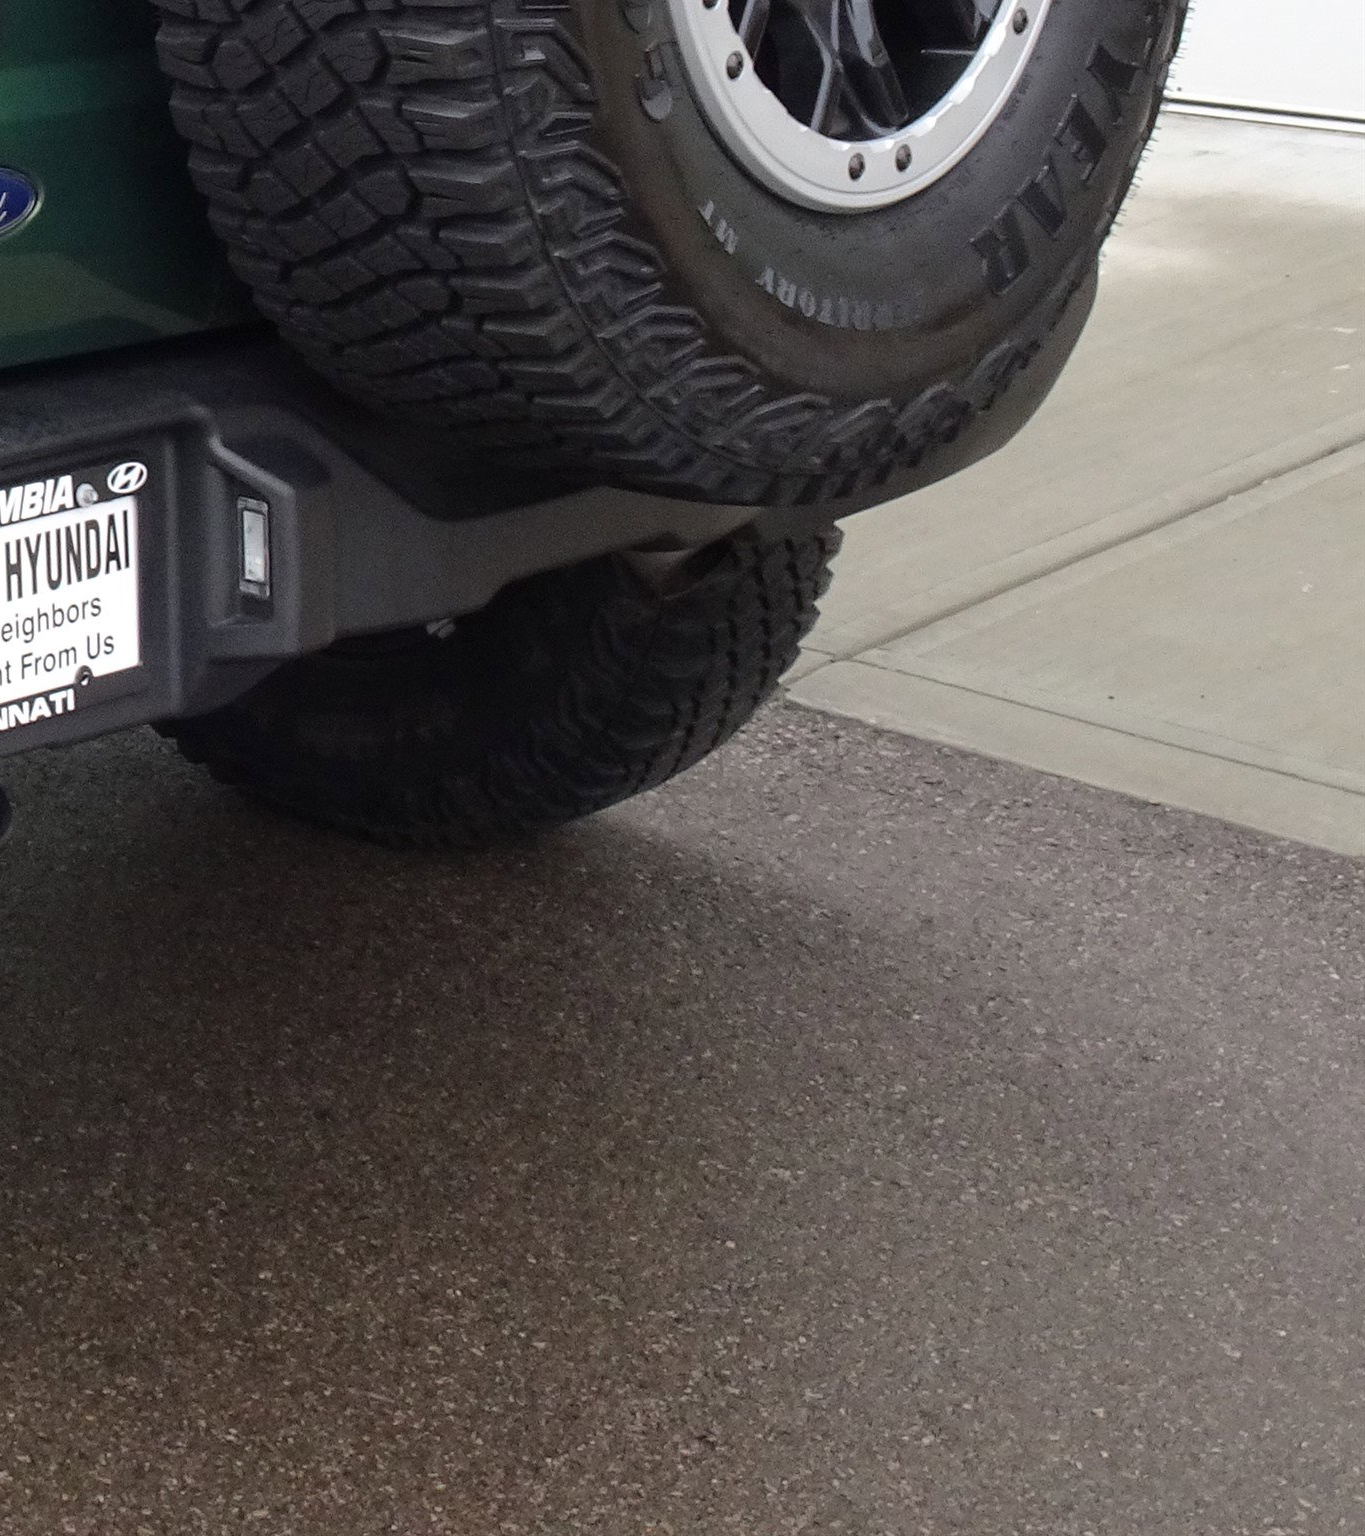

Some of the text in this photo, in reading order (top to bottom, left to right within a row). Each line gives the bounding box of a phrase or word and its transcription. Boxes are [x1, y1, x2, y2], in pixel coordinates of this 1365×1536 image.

[4, 509, 132, 602] HYUNDAI
[20, 644, 78, 681] From
[86, 632, 115, 659] Us
